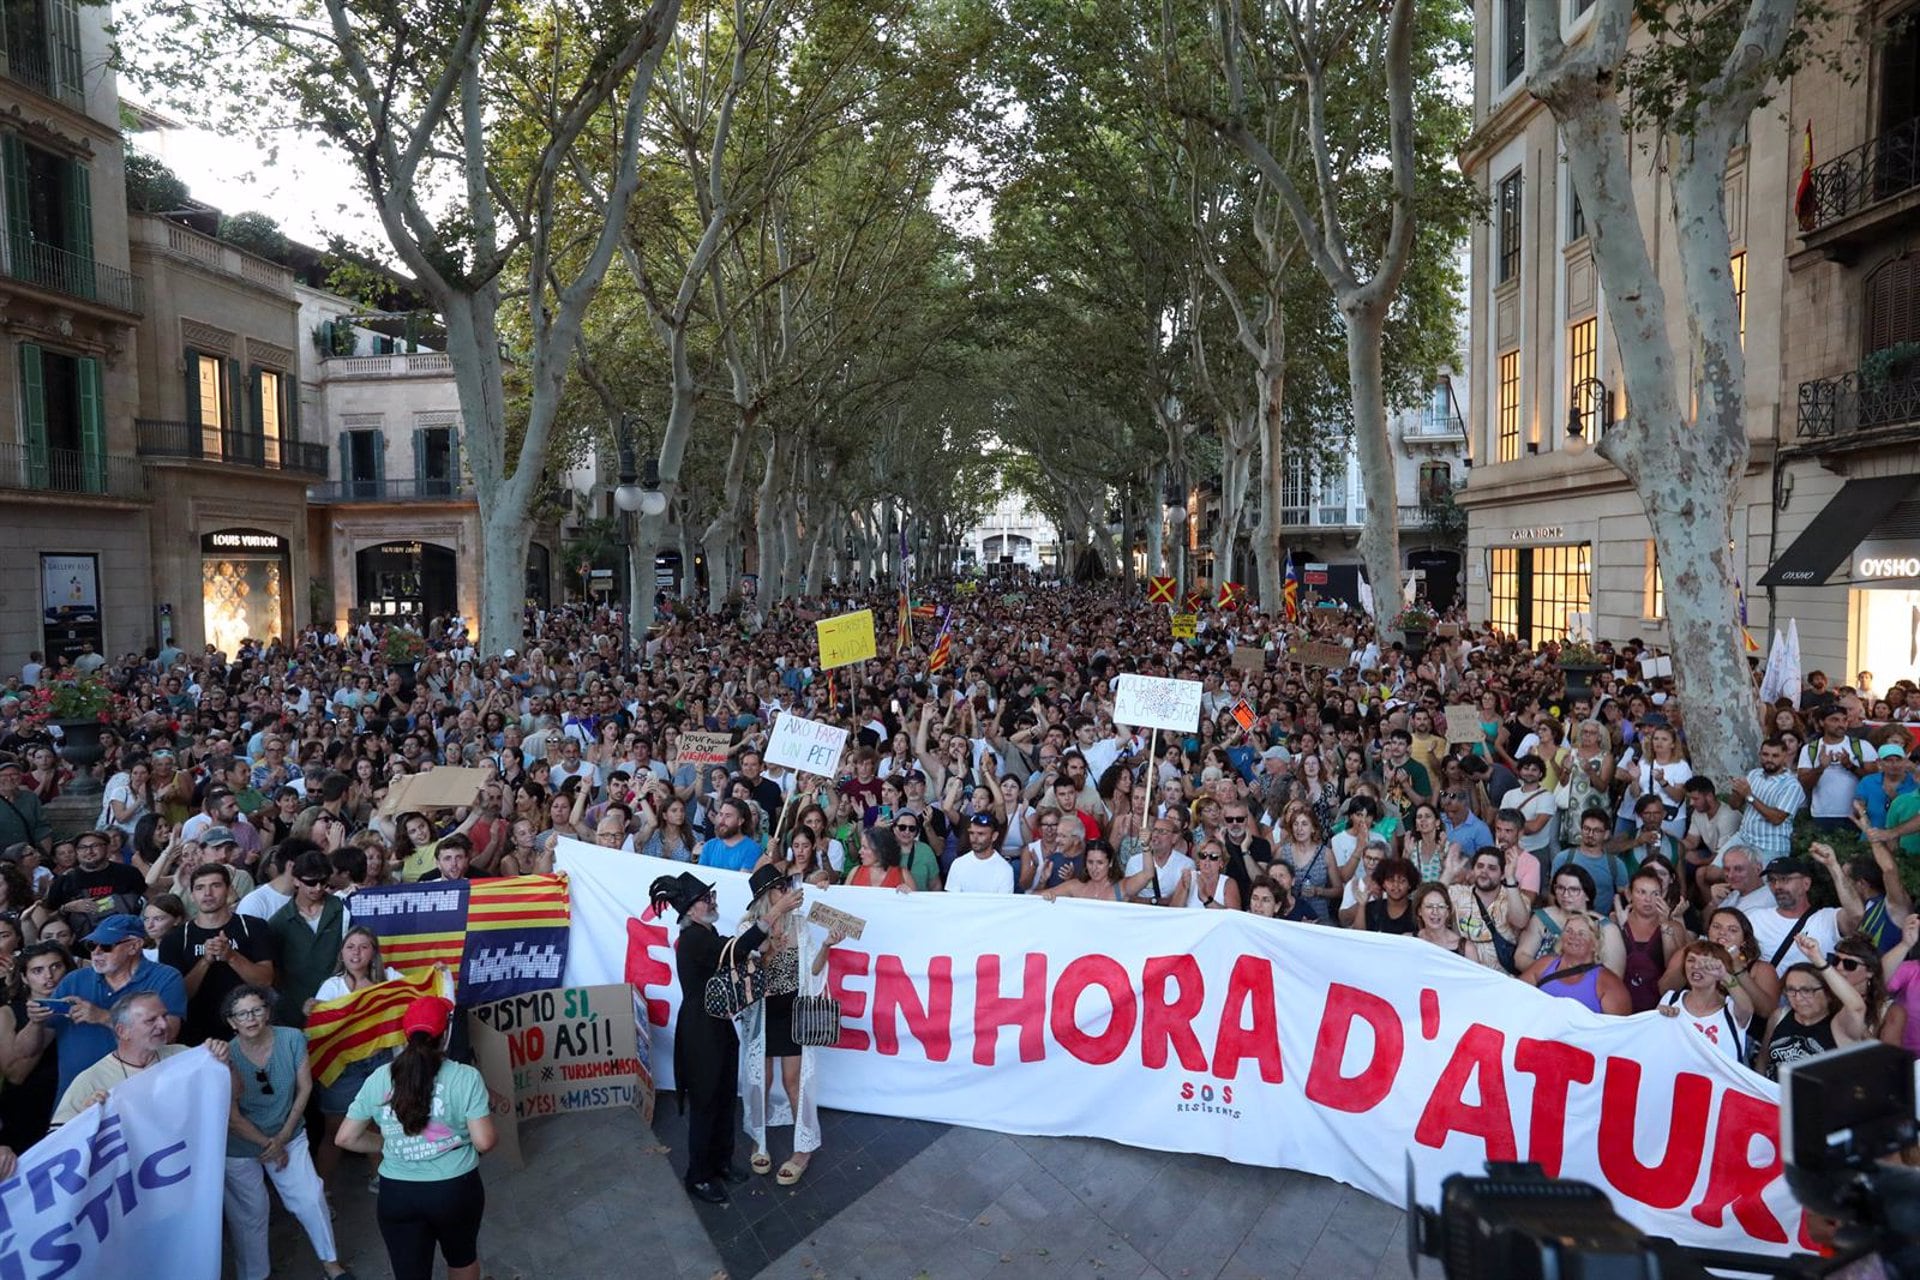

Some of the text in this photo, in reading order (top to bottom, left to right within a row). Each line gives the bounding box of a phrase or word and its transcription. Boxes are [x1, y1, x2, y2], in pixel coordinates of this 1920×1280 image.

[213, 534, 240, 546] LOUIS
[1782, 571, 1815, 580] OYSHO
[1860, 558, 1920, 577] OYSHO
[507, 1026, 545, 1070] NO
[1181, 1082, 1233, 1104] SOS
[972, 952, 1284, 1084] HORA
[1305, 982, 1825, 1255] D'ATUR
